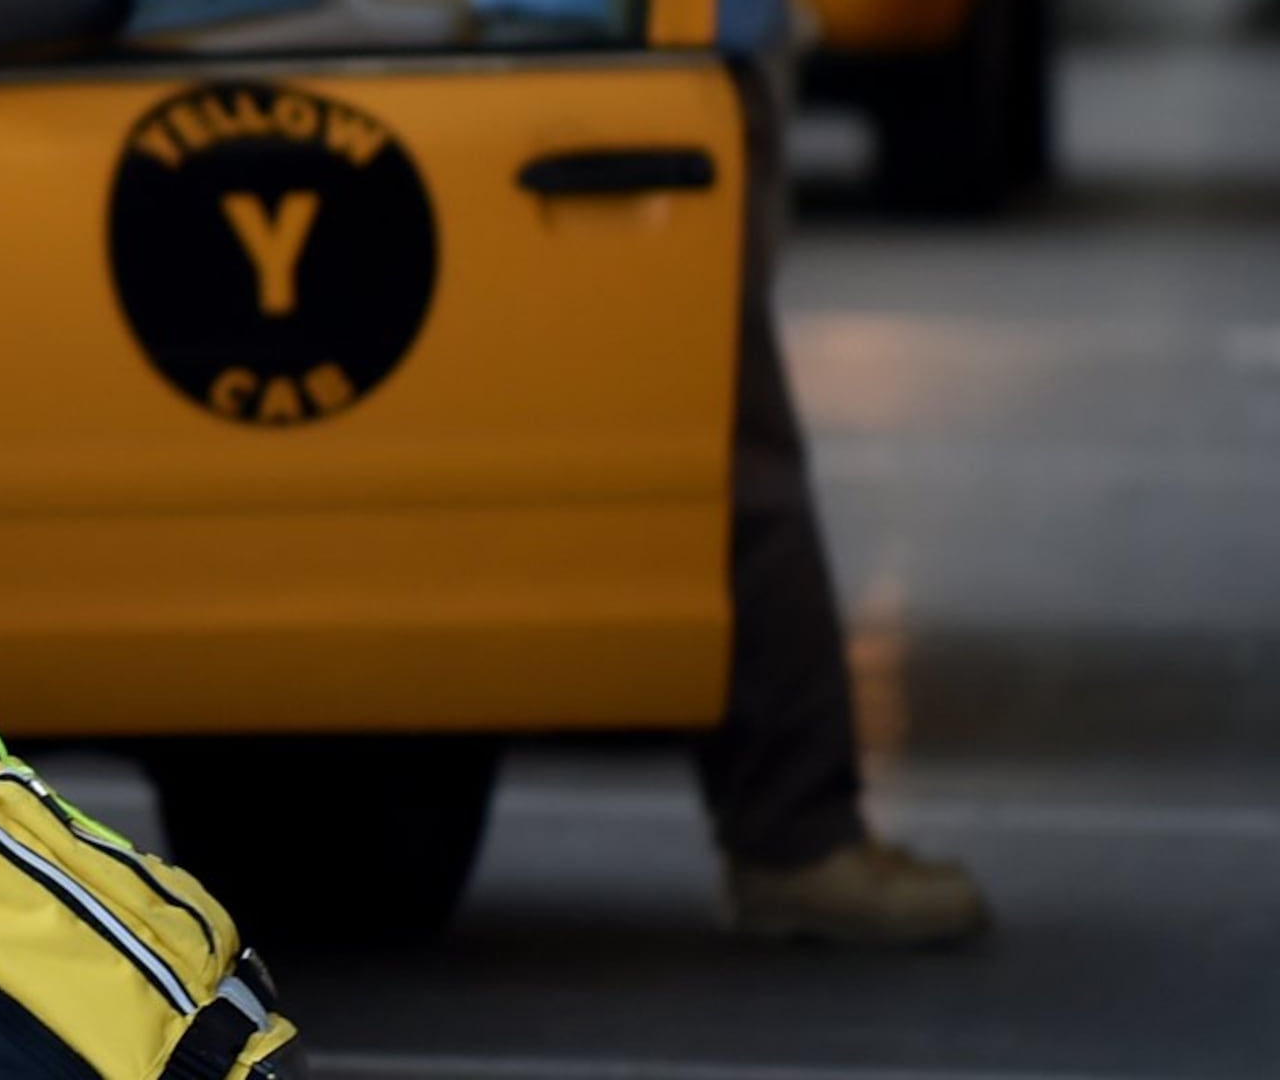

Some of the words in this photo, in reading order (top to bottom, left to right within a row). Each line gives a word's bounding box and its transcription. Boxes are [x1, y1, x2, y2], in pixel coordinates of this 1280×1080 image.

[136, 88, 390, 171] YELLOW
[219, 189, 323, 315] Y
[207, 363, 357, 421] CAB
